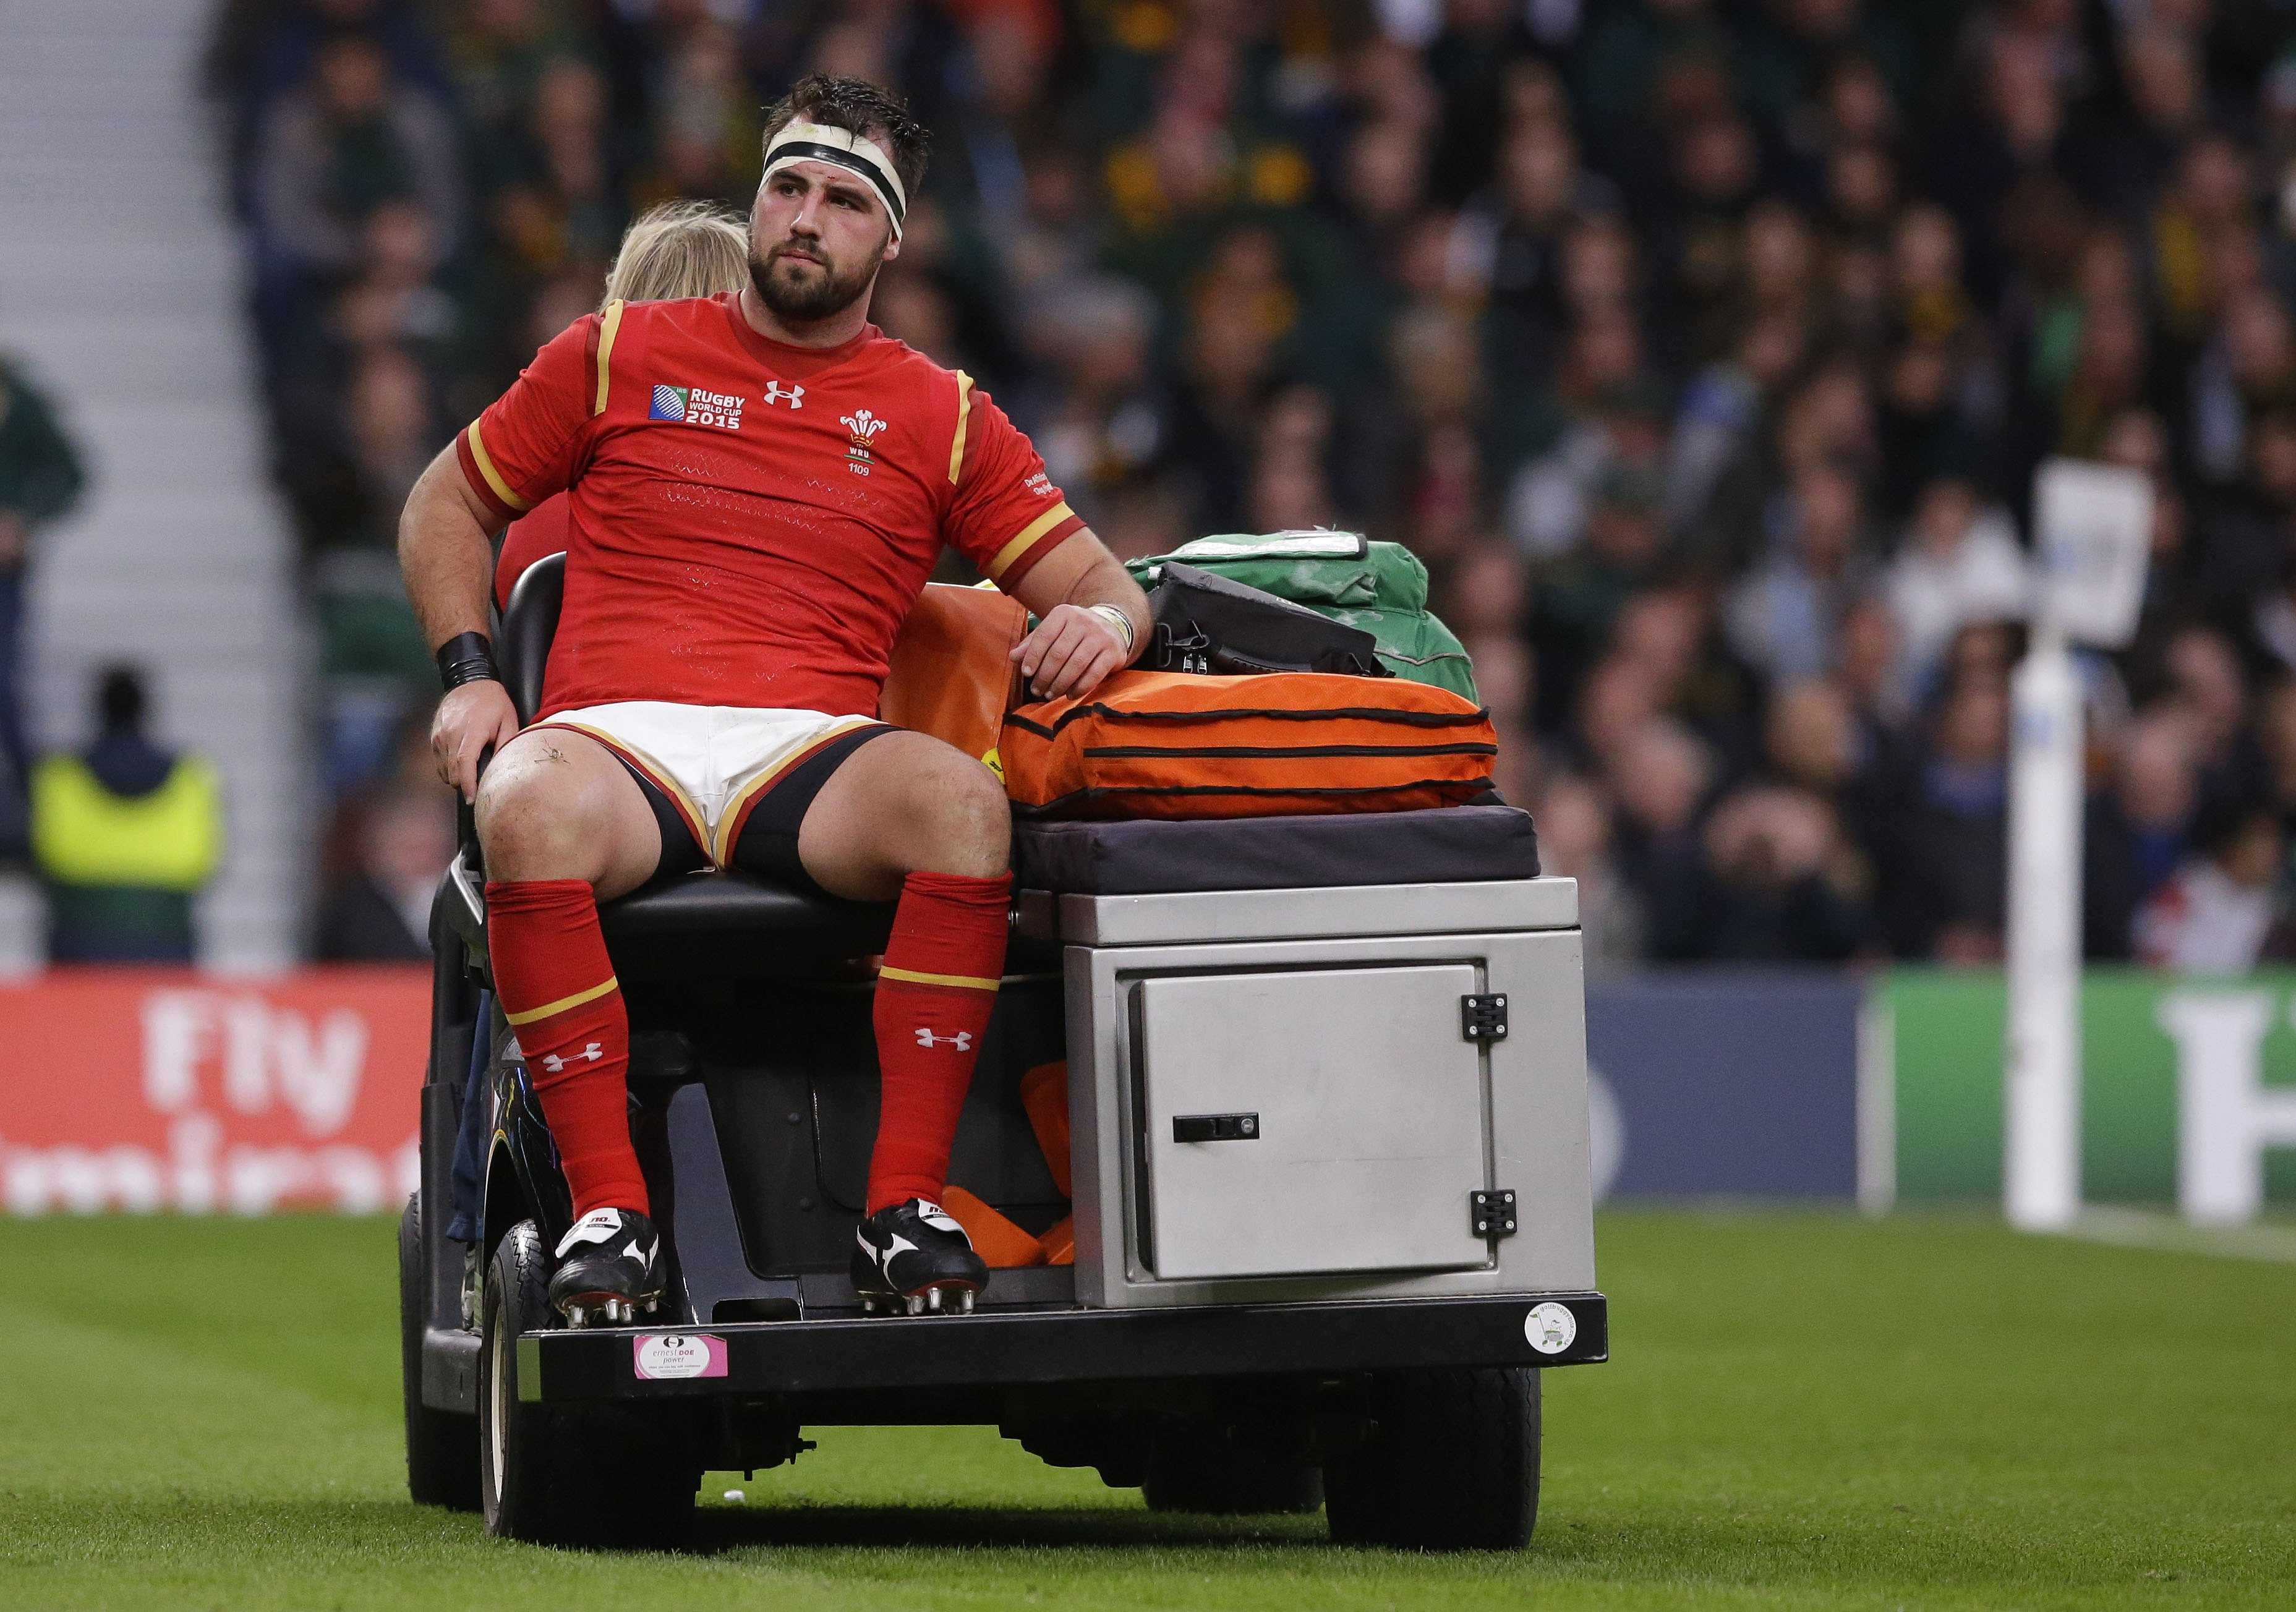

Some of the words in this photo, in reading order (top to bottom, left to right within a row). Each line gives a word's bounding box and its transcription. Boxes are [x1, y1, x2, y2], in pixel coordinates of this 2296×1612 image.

[690, 388, 746, 409] RUGBY
[689, 402, 722, 414] WORLD
[723, 408, 742, 417] CUP
[686, 410, 740, 429] 2015
[849, 446, 869, 458] WRU
[848, 463, 870, 476] 1109
[142, 987, 367, 1136] Fly
